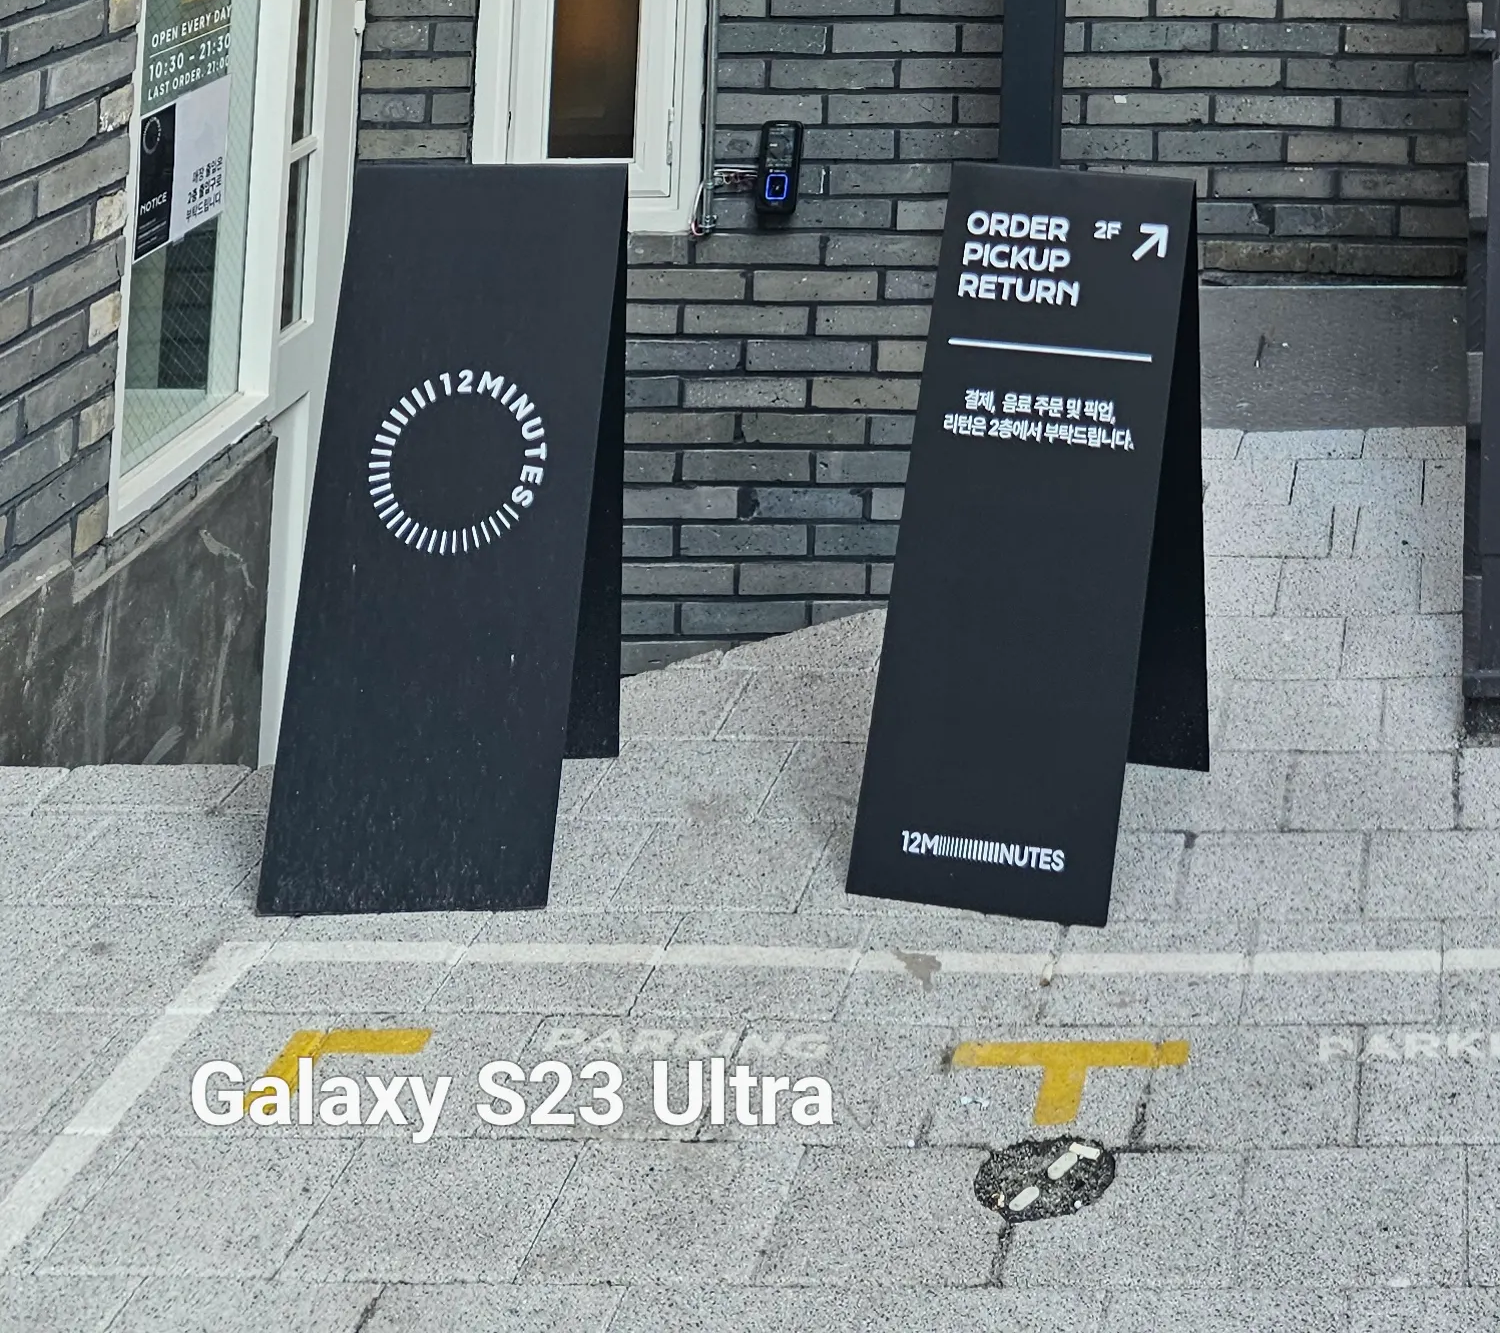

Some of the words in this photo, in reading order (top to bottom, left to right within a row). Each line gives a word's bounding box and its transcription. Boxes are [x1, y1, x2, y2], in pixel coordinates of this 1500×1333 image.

[152, 26, 179, 48] OPEN
[181, 12, 212, 37] EVERY
[214, 5, 232, 24] DAY
[150, 52, 184, 82] 10:30
[199, 32, 231, 61] 21:30
[148, 80, 170, 101] LAST
[207, 54, 229, 75] 21:00
[140, 191, 168, 216] NOTICE
[967, 209, 1070, 242] ORDER
[1093, 220, 1122, 240] 2F
[962, 241, 1071, 273] PICKUP
[957, 272, 1080, 307] RETURN
[964, 388, 996, 414] 결제,
[1002, 391, 1032, 414] 음료
[1033, 395, 1064, 418] 주문
[1066, 397, 1081, 419] 및
[1084, 399, 1116, 425] 픽업,
[439, 369, 548, 508] 12MINUTES
[943, 413, 987, 437] 리턴은
[988, 416, 1043, 443] 2층에서
[1044, 422, 1135, 452] 부탁드립니다.
[542, 1028, 830, 1060] PARKING
